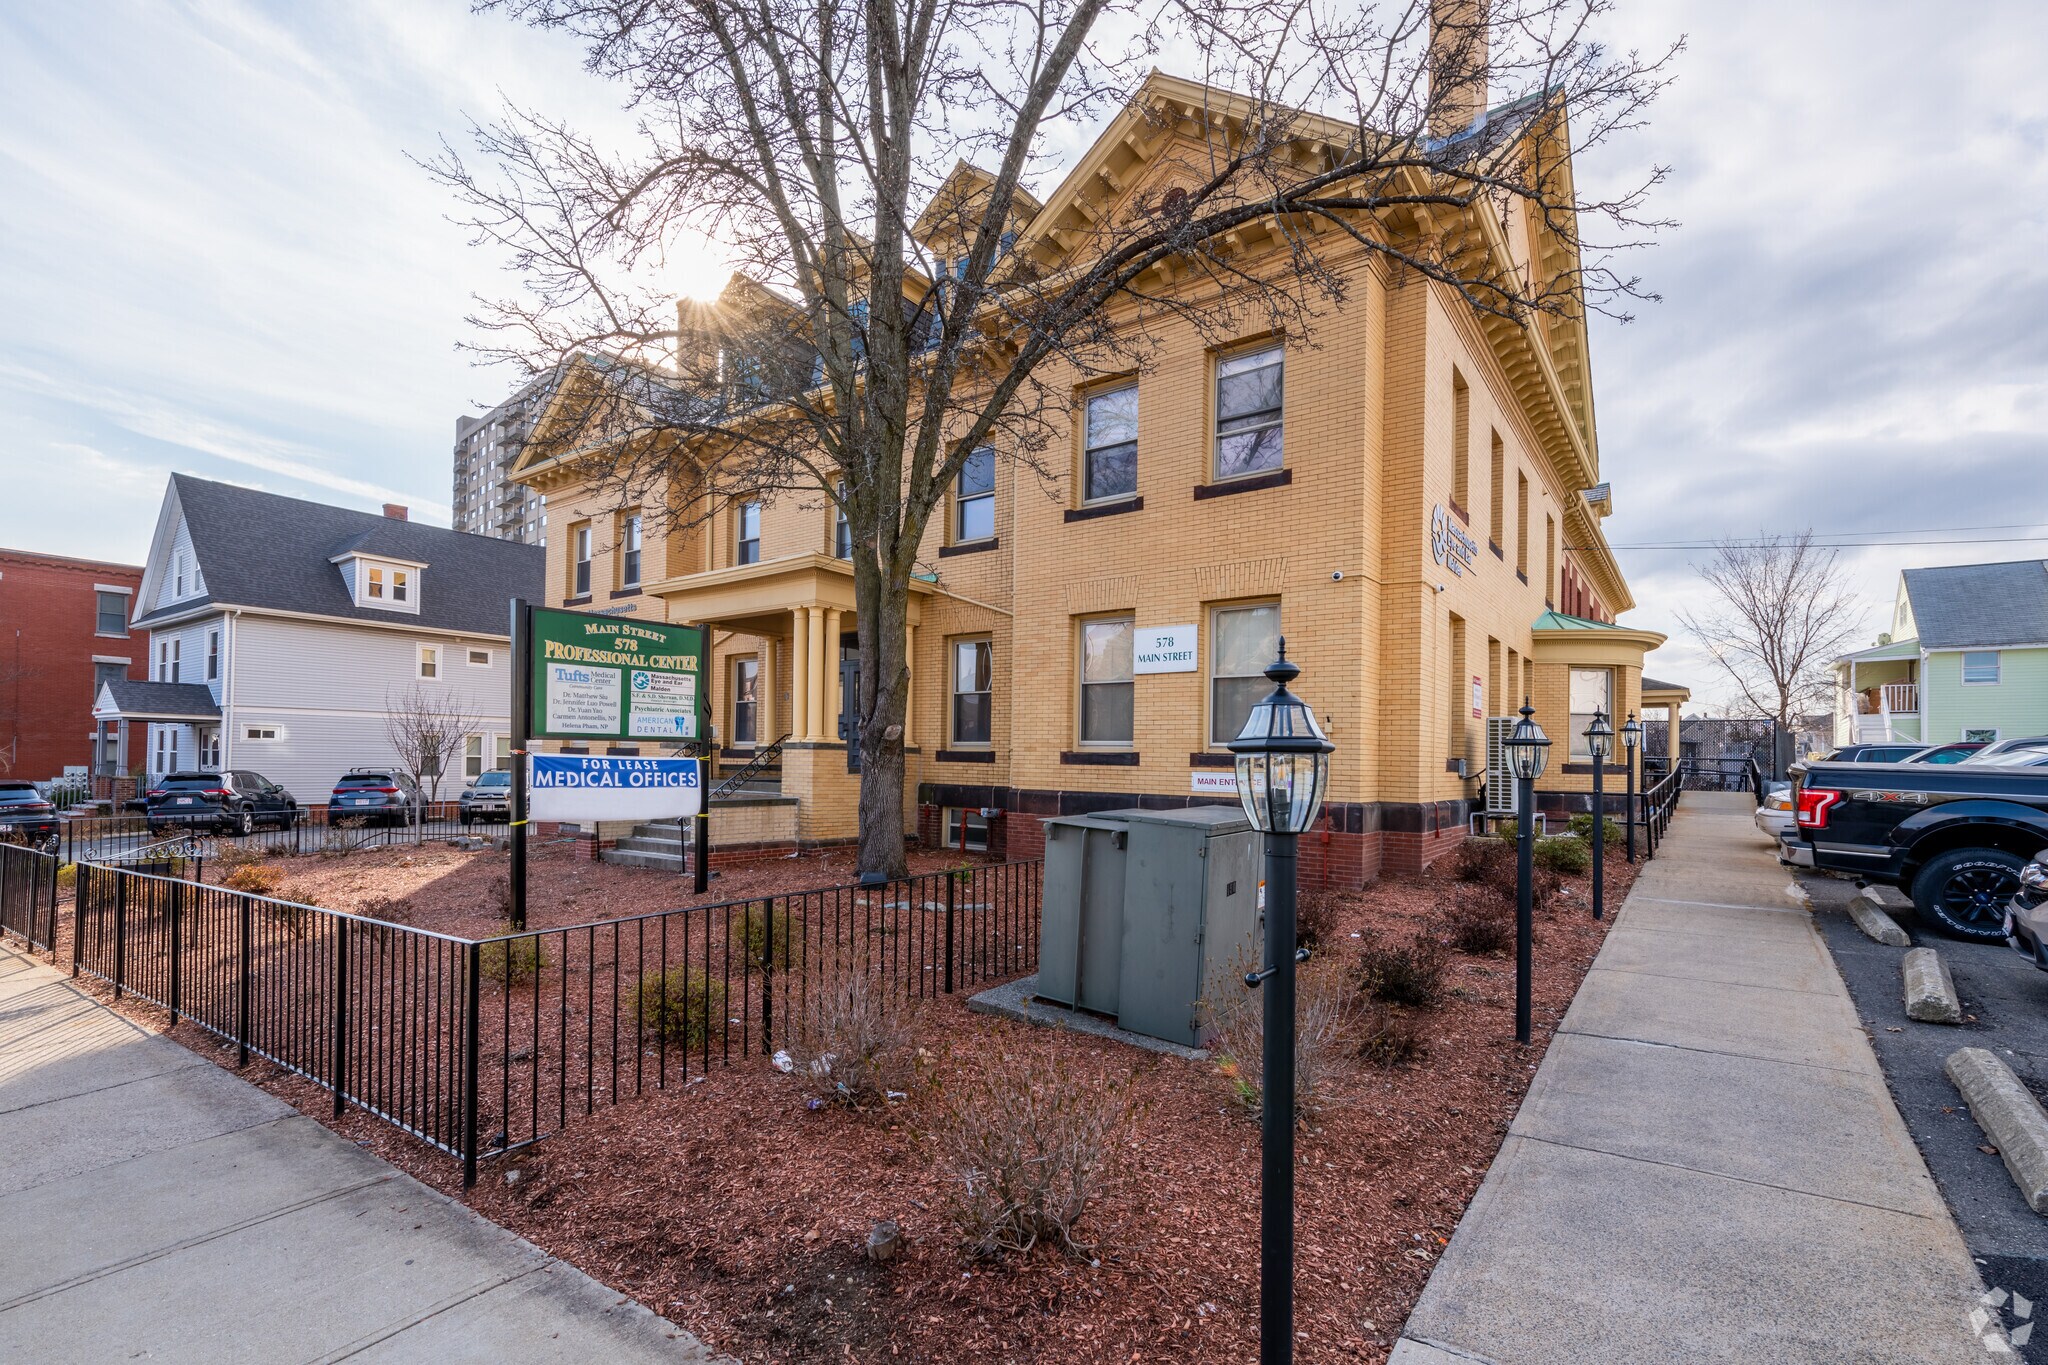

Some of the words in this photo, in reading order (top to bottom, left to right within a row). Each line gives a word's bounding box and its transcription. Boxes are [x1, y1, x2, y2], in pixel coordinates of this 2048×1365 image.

[584, 623, 619, 635] MAIN
[622, 624, 667, 644] STREET
[614, 637, 638, 651] 578
[1156, 636, 1174, 648] 578
[544, 639, 648, 667] PROFESSIONAL
[650, 655, 698, 671] CENTER
[1137, 653, 1161, 662] MAIN
[1162, 651, 1192, 661] STREET
[555, 668, 590, 682] Tufts
[591, 671, 616, 679] Medical
[650, 674, 692, 682] Massachusetts
[573, 692, 598, 700] Matthew
[634, 705, 664, 713] Psychiatric
[637, 716, 674, 725] AMERICAN
[636, 725, 673, 734] DENTAL
[582, 759, 611, 770] FOR
[617, 760, 659, 770] LEASE
[535, 770, 623, 787] MEDICAL
[629, 771, 697, 787] OFFICES
[1952, 861, 2021, 878] GOODYEA
